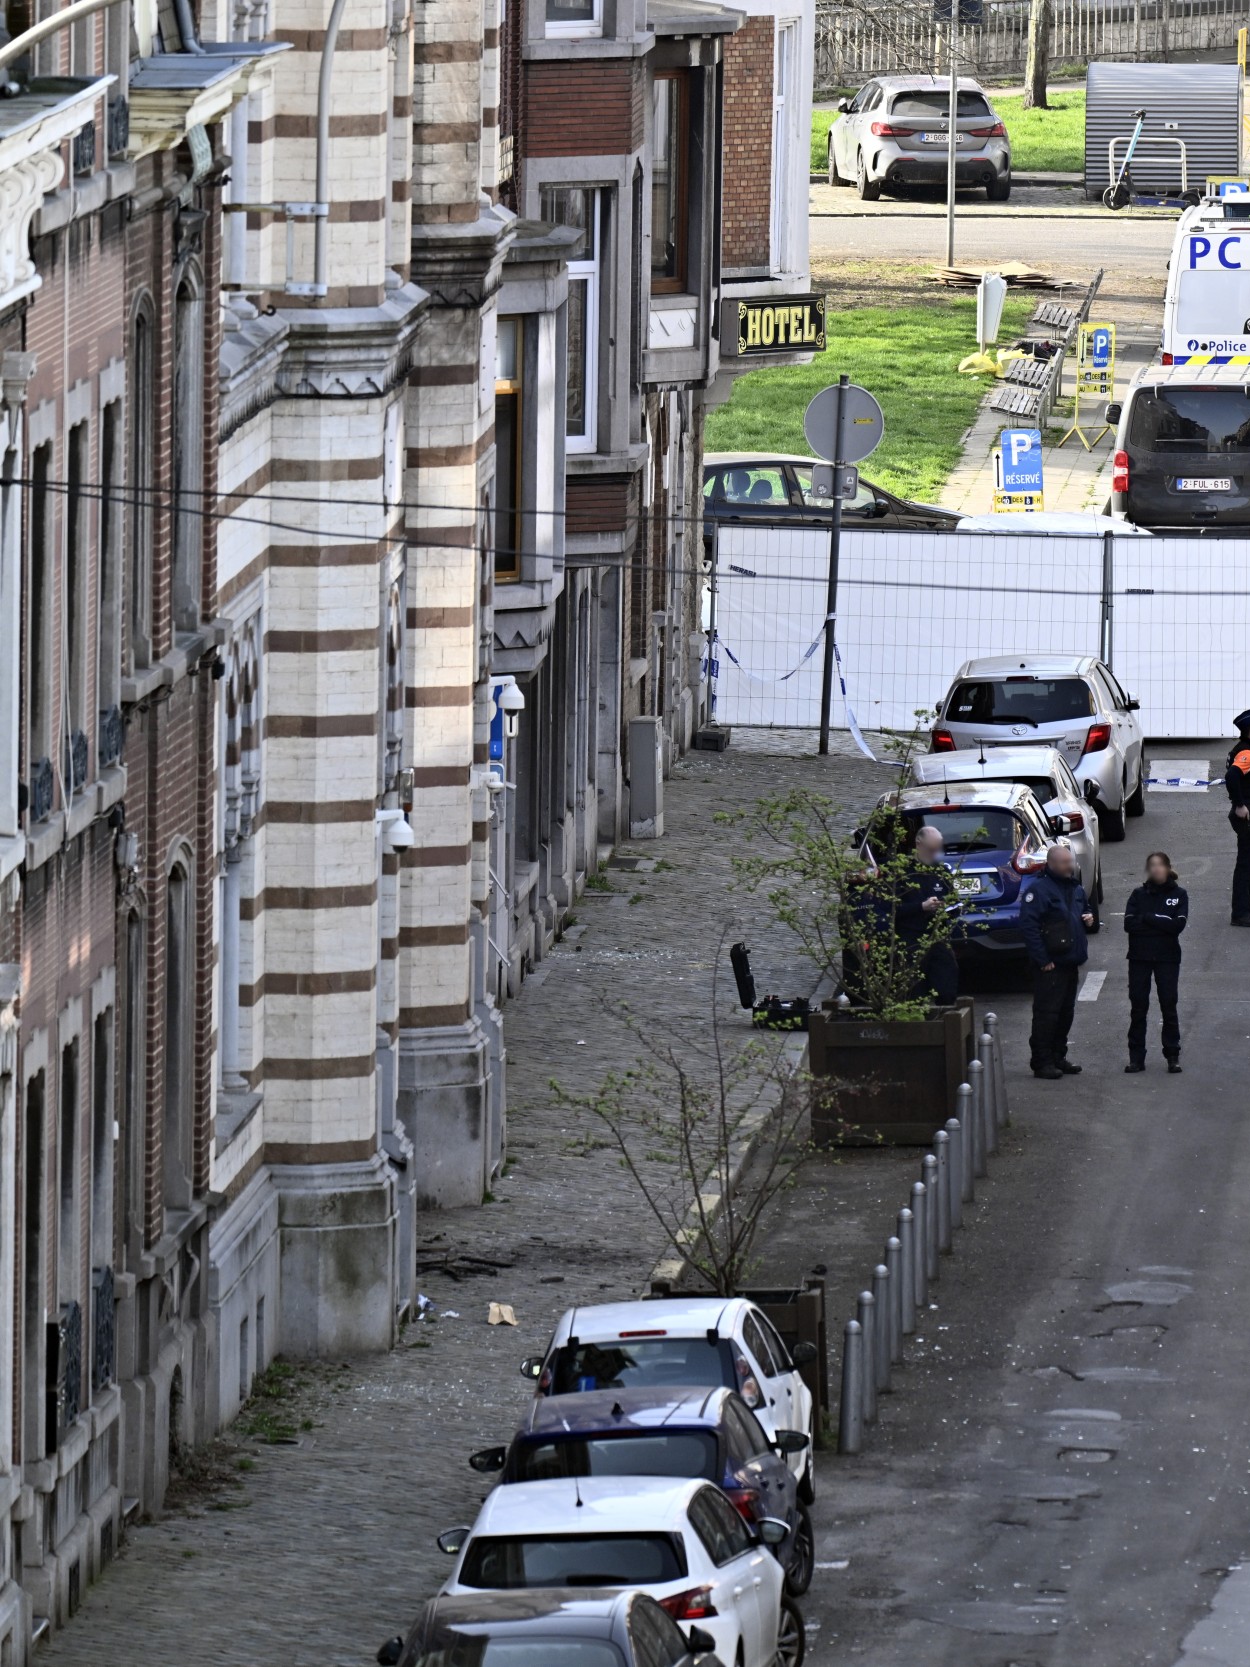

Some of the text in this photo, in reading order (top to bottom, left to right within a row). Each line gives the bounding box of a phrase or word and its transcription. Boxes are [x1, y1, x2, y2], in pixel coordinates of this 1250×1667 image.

[747, 306, 816, 345] HOTEL
[1096, 335, 1107, 354] P
[1208, 341, 1247, 352] Police
[1010, 433, 1032, 466] P
[1005, 471, 1041, 485] RÉSERVÉ
